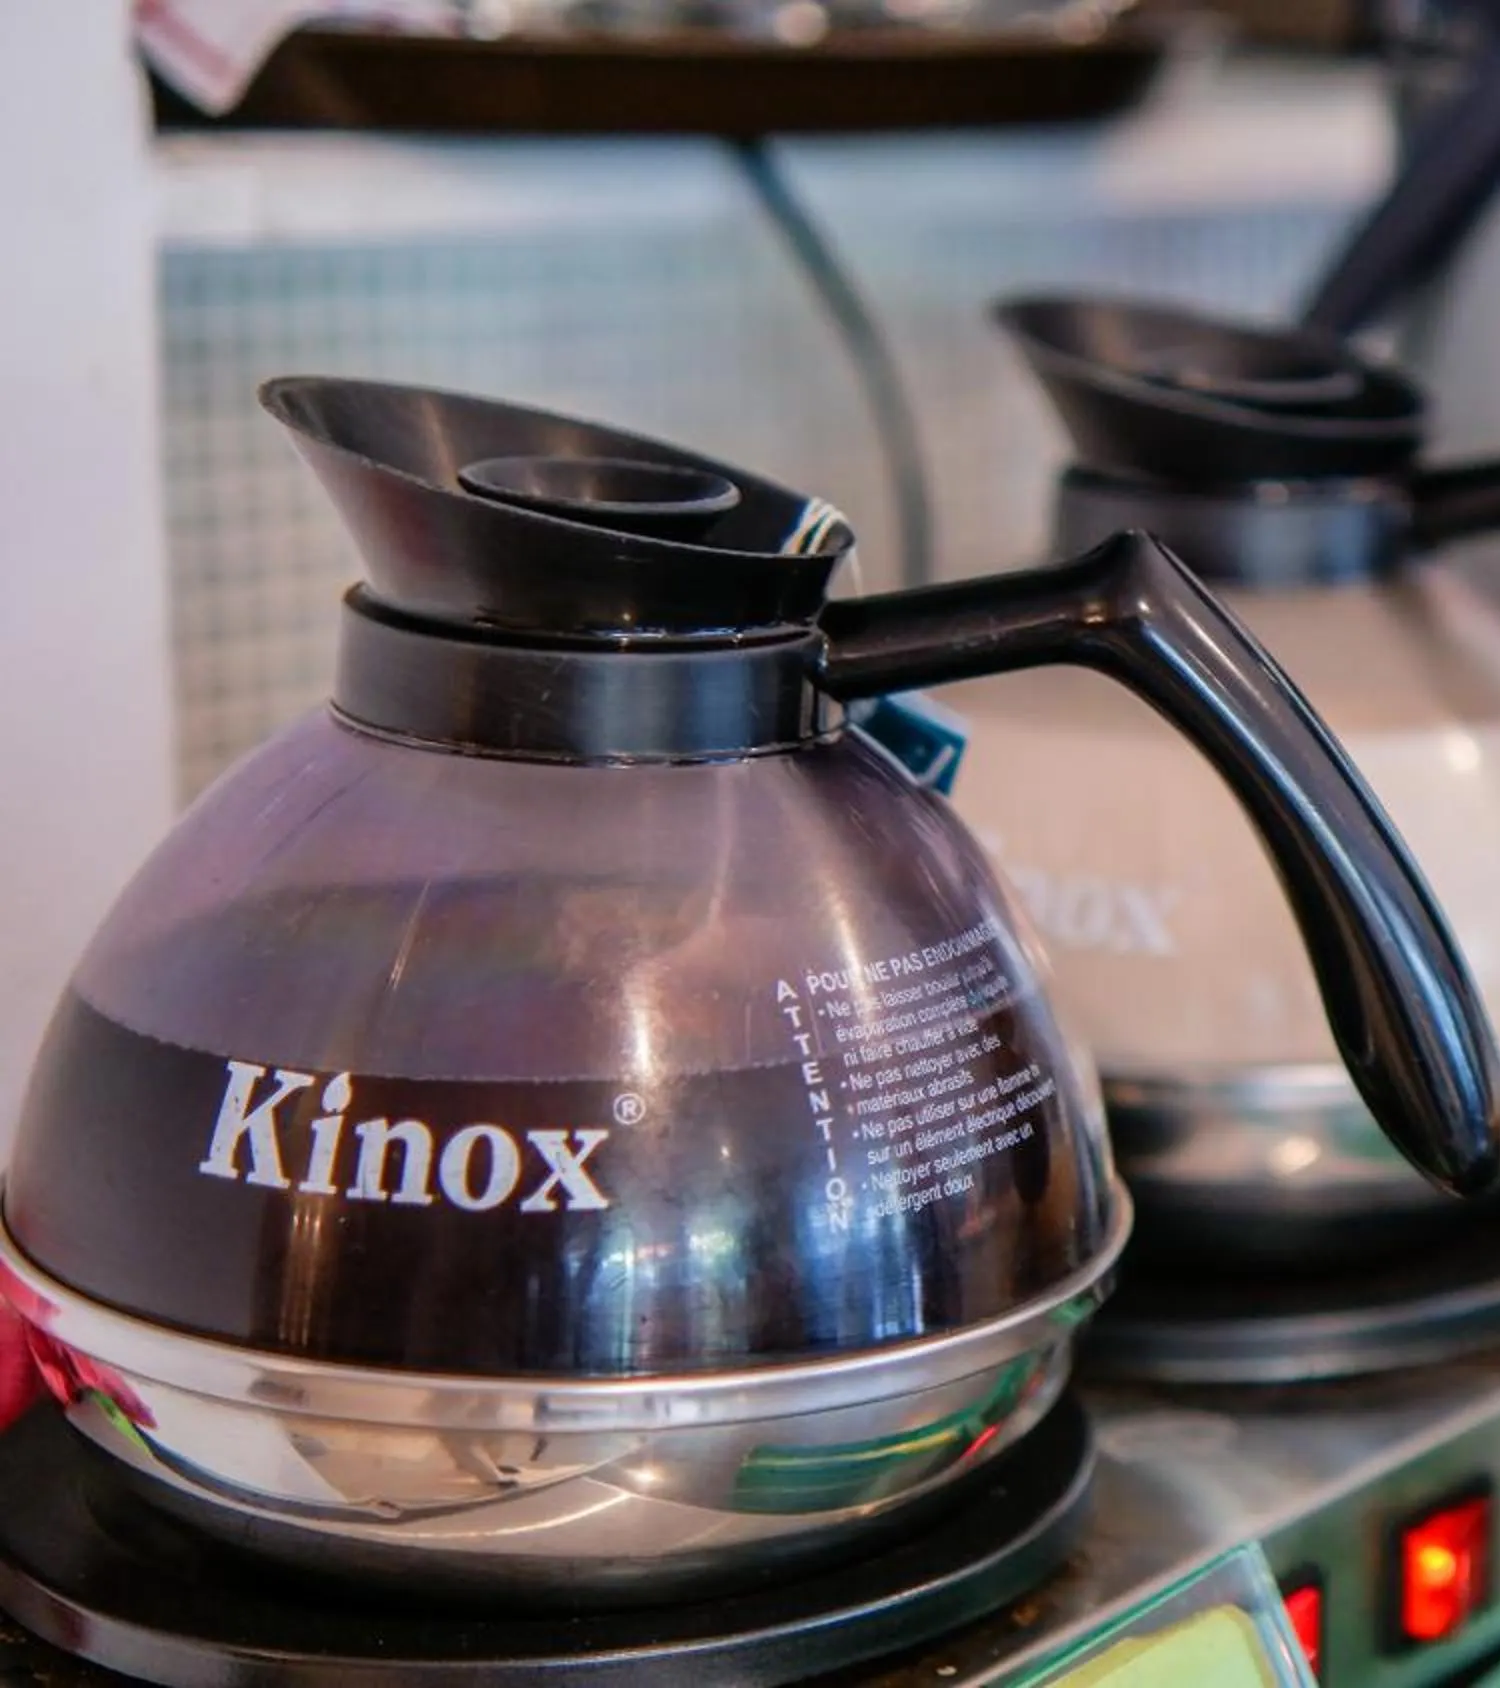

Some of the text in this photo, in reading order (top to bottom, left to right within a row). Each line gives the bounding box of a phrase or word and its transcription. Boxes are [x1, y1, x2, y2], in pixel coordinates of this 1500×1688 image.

[805, 970, 865, 996] POU
[863, 960, 891, 983] NE
[889, 952, 924, 977] PAS
[825, 999, 852, 1019] Ne
[879, 983, 923, 1008] laisser
[848, 1033, 1002, 1091] Ne pas nettoyer avec des
[926, 1069, 975, 1099] abrasifs
[860, 1119, 886, 1141] Ne
[887, 1114, 914, 1138] pas
[957, 1093, 977, 1112] sur
[976, 1084, 999, 1103] une
[200, 1060, 609, 1216] Kinox
[867, 1145, 892, 1166] sur
[892, 1140, 914, 1159] un
[932, 1137, 995, 1175] seulement
[994, 1128, 1023, 1152] avec
[942, 1172, 975, 1197] doux
